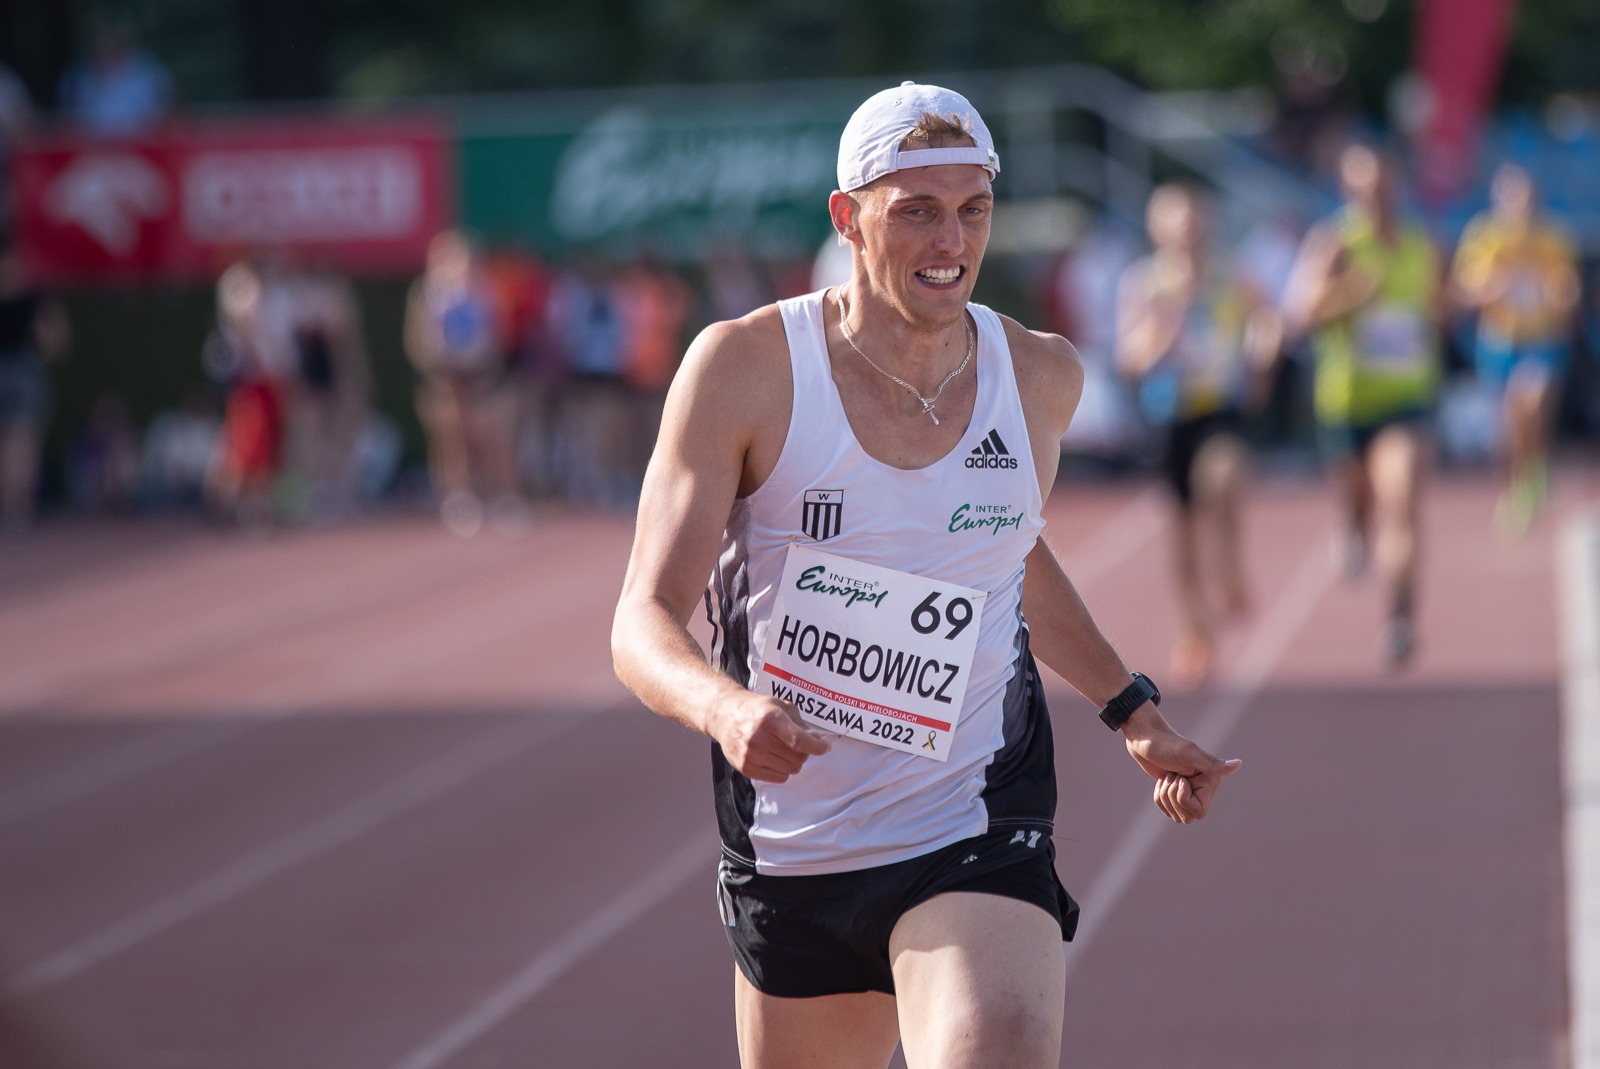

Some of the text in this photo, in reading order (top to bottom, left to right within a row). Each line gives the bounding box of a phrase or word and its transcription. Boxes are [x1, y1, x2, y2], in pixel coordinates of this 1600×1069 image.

[964, 454, 1018, 470] adidas
[818, 493, 830, 501] W
[948, 503, 1024, 536] Europol
[796, 565, 889, 609] Europol
[910, 591, 974, 641] 69
[776, 614, 960, 705] HORBOWICZ
[771, 680, 915, 746] WARSZAWA 2022
[790, 676, 918, 723] MISTRZOSTWA POLSKI W WIELOBOJACH
